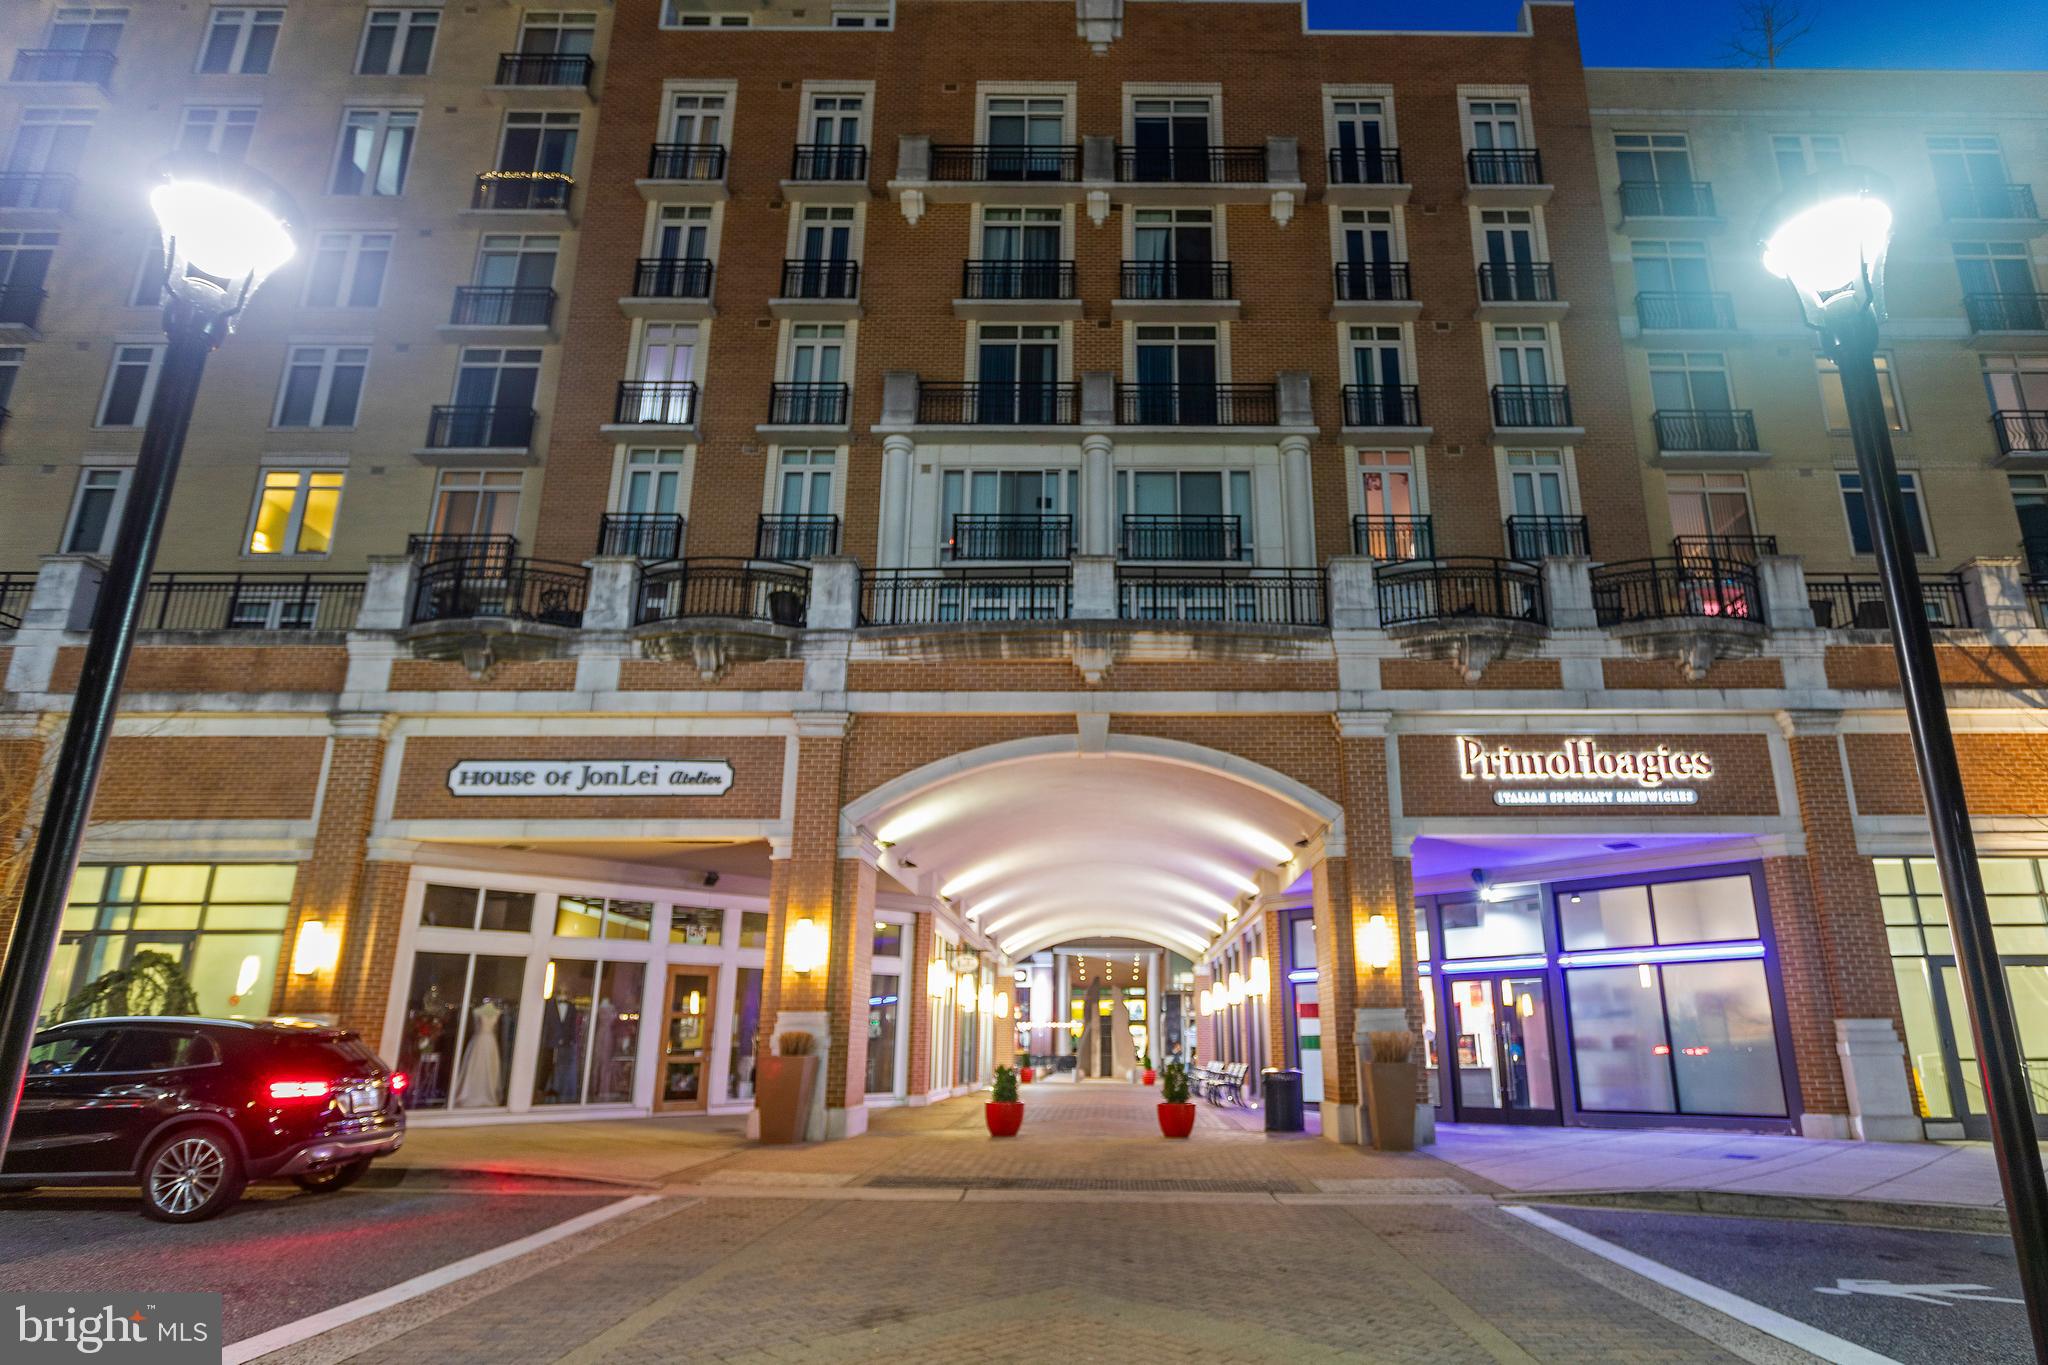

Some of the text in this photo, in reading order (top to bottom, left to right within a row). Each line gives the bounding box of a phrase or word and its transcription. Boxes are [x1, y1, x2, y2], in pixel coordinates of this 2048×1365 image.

[1458, 736, 1713, 786] PrimoHoagies
[576, 764, 660, 791] JonLei
[1498, 791, 1694, 804] ITALIAN SPECIALTY SANDWICHES
